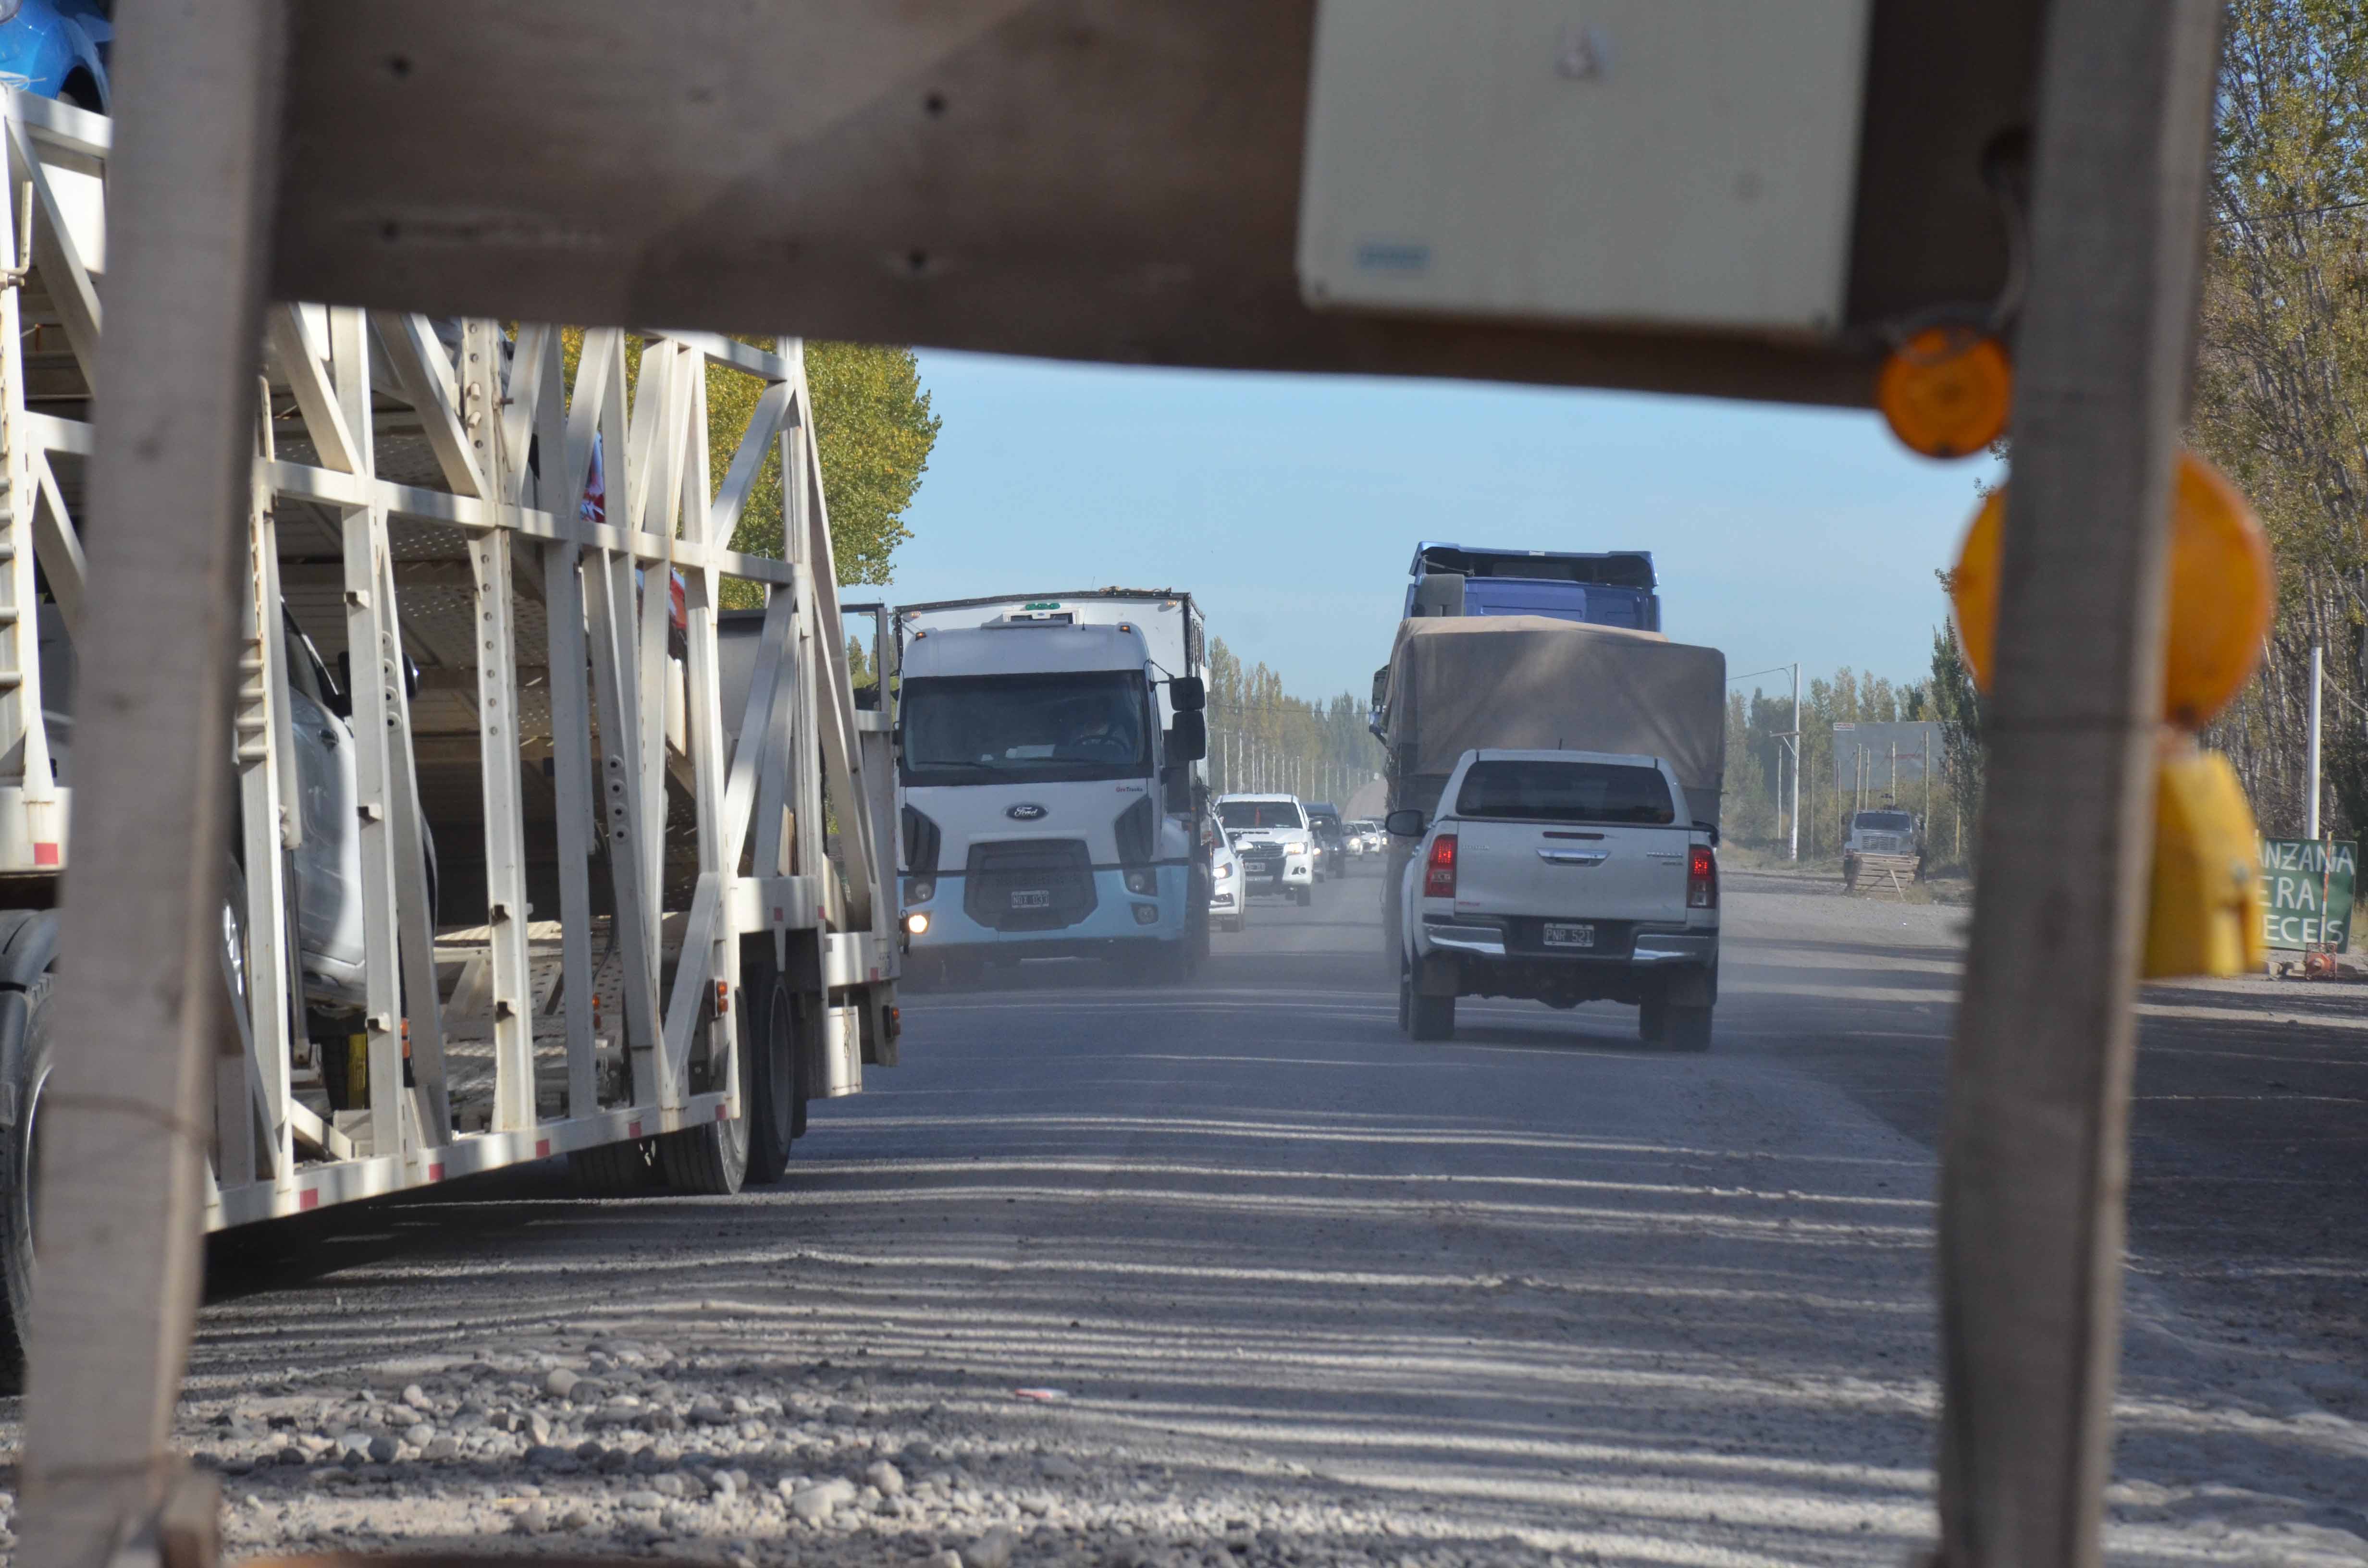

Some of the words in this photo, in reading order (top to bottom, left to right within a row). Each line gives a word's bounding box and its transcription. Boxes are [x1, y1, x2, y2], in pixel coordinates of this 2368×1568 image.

[1014, 807, 1038, 817] Ford
[2258, 875, 2315, 911] ERA
[1546, 929, 1566, 942] PNR
[1572, 930, 1591, 942] 521
[2263, 914, 2343, 944] ECES
